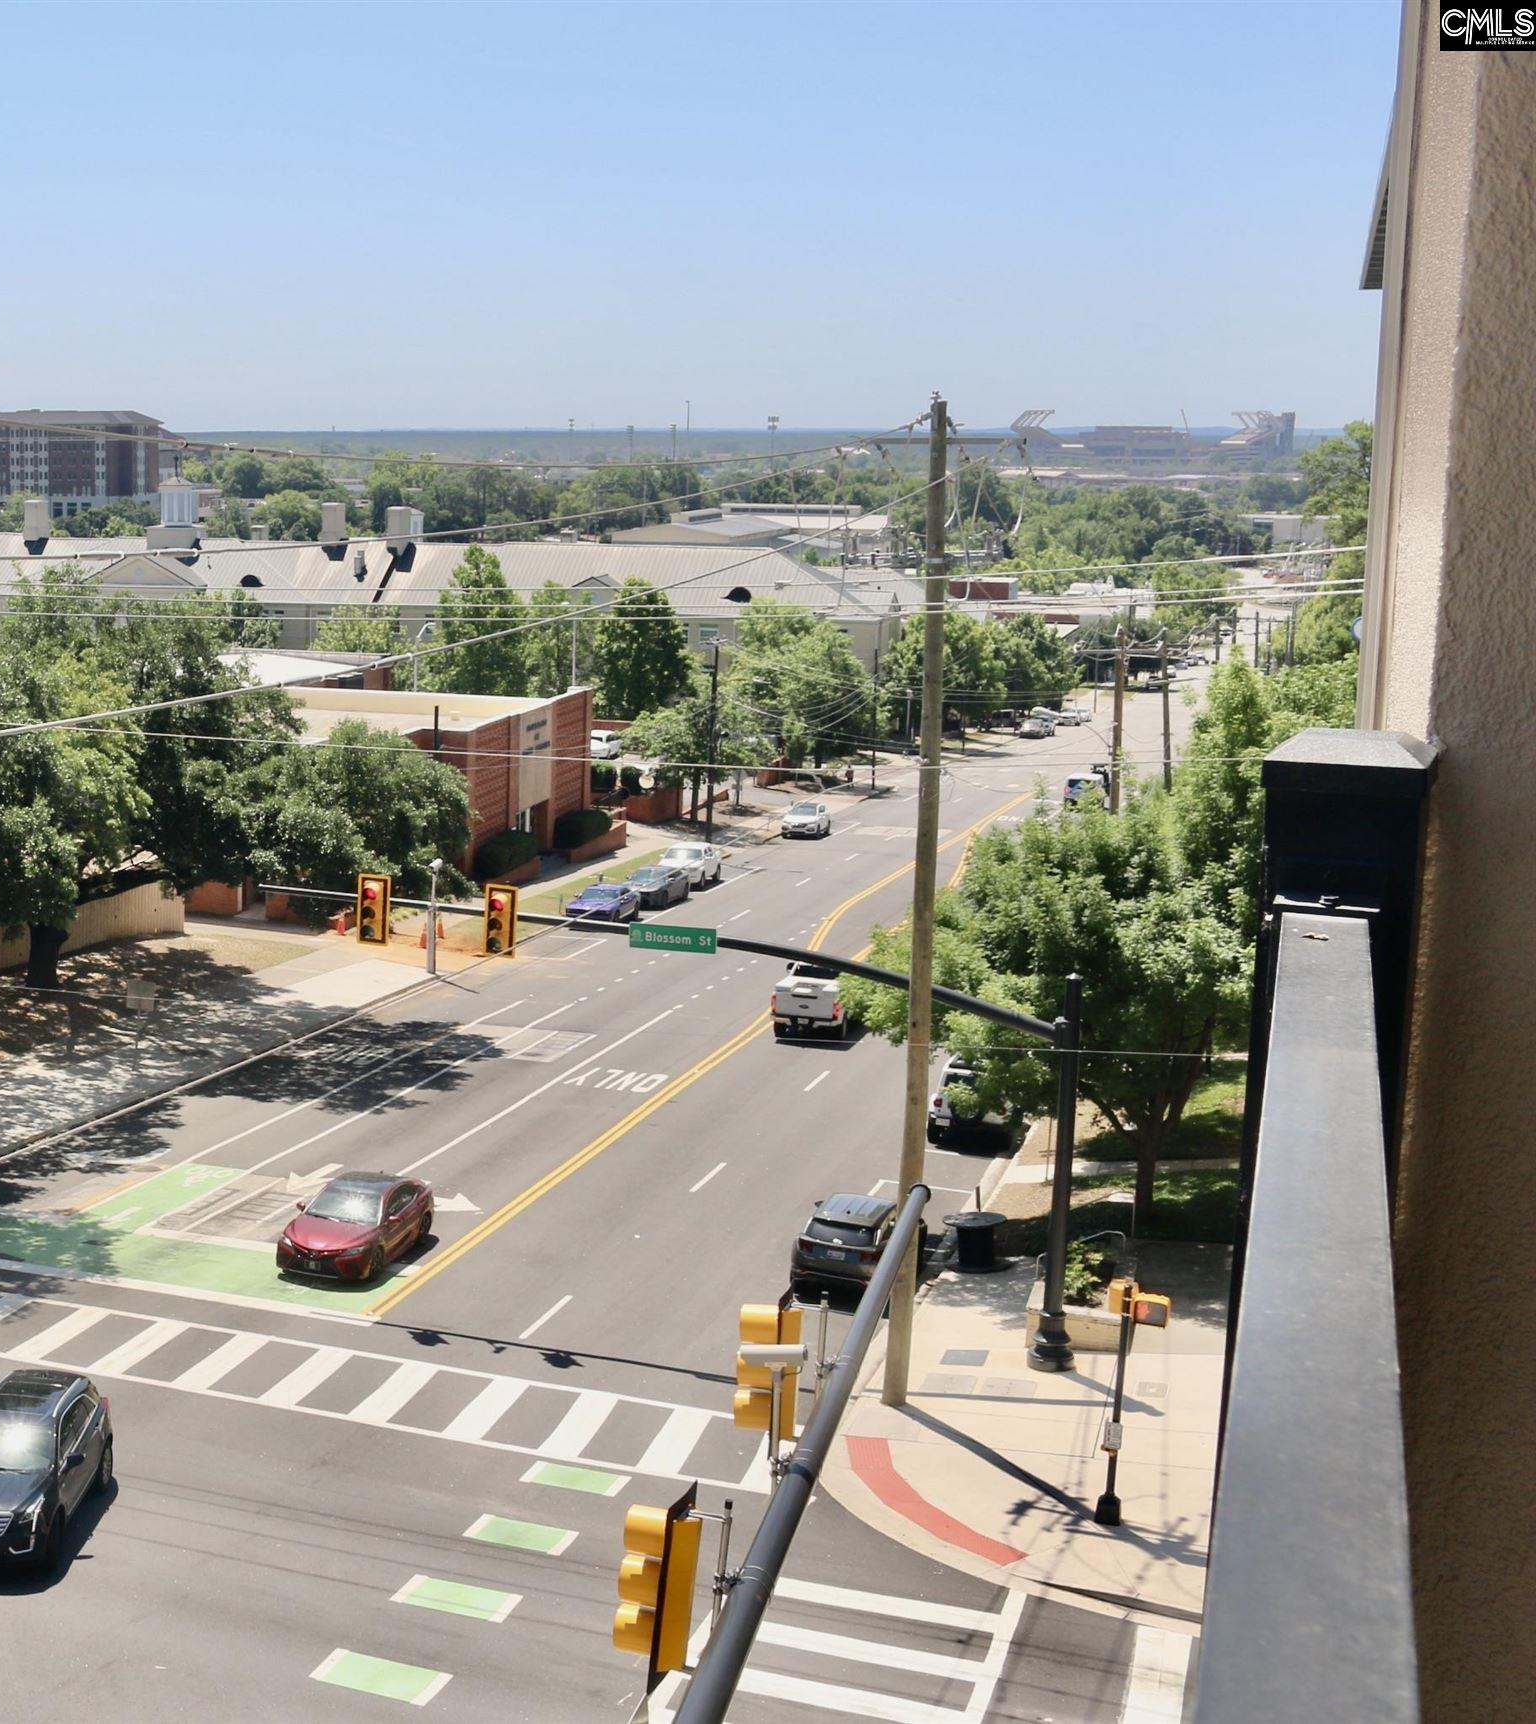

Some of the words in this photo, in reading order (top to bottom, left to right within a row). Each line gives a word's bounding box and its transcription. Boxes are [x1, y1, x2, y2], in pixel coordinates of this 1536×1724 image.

[645, 931, 692, 945] Blossom
[699, 935, 712, 946] St
[563, 1067, 669, 1093] ONLY
